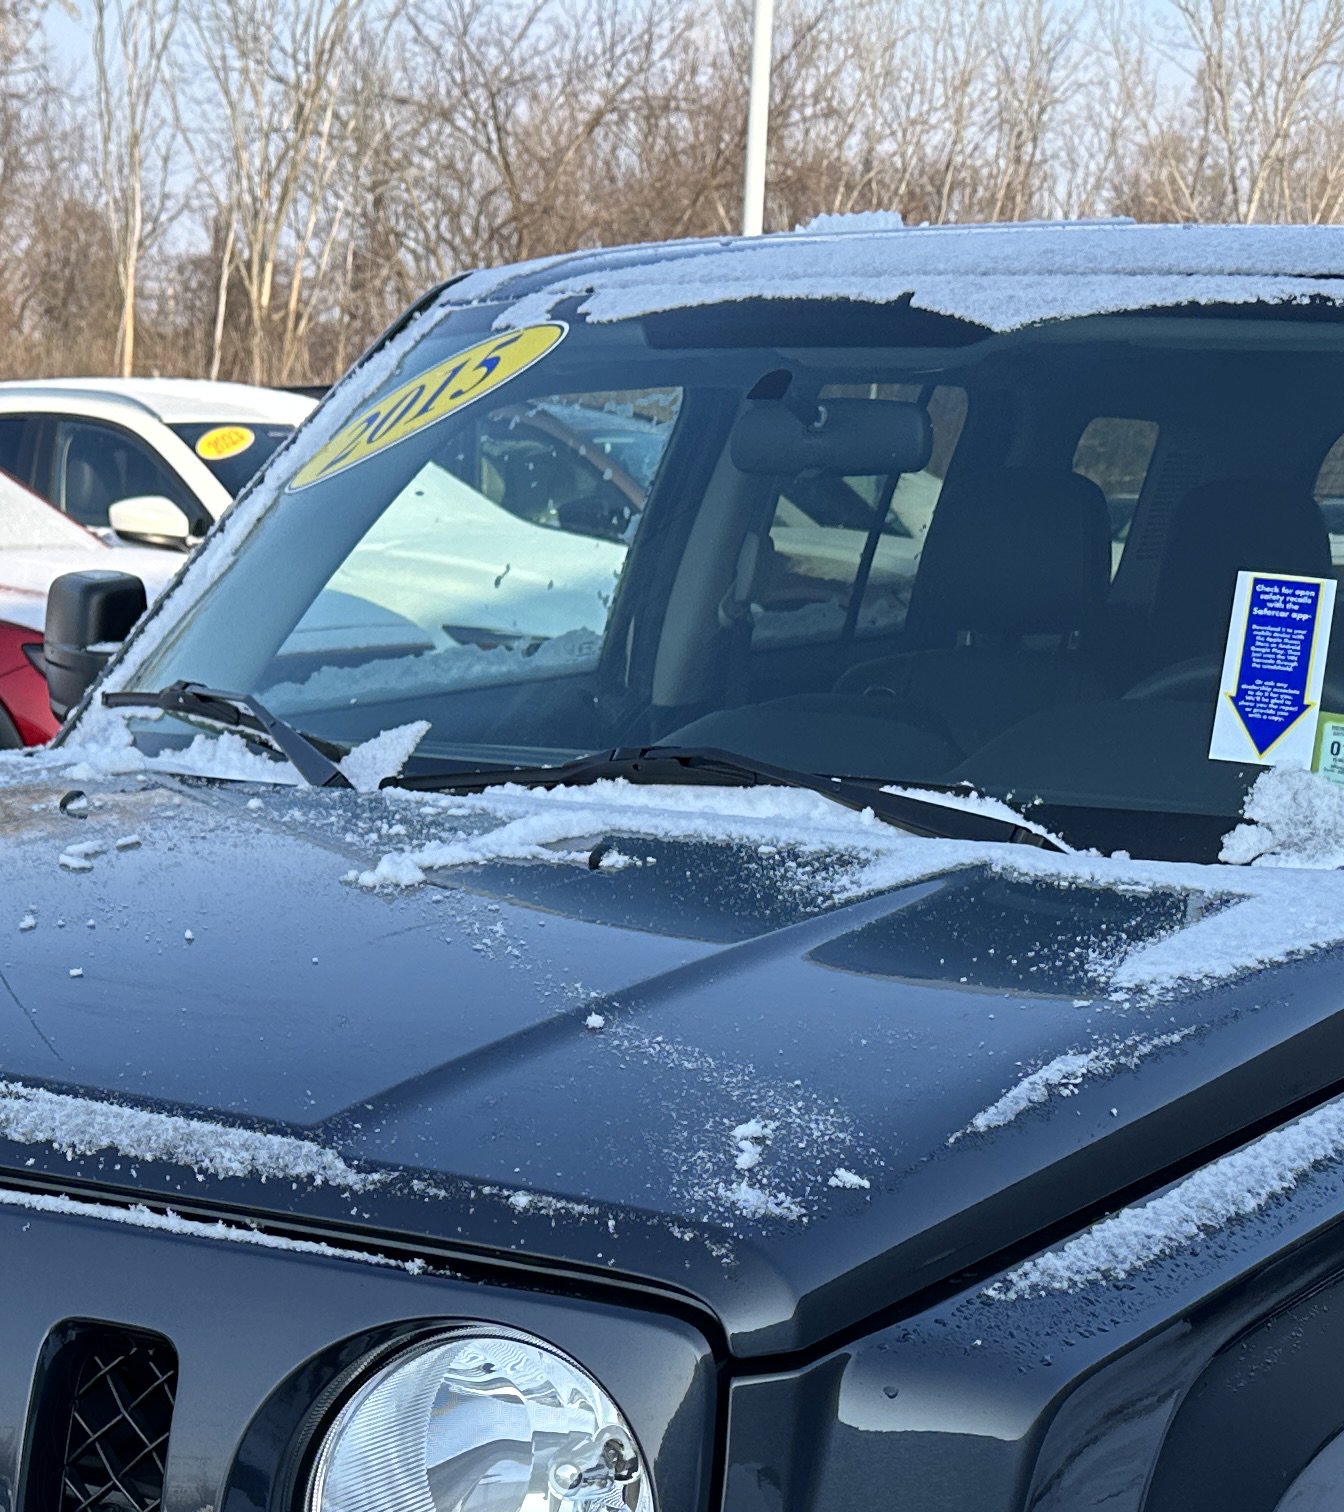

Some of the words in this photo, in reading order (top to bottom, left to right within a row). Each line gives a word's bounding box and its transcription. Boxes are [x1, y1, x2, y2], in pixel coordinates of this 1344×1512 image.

[316, 333, 524, 478] 2015
[1256, 584, 1279, 593] Check
[1282, 586, 1293, 594] for
[1295, 589, 1315, 597] open
[1260, 593, 1284, 604] safety
[1286, 596, 1311, 604] recalls
